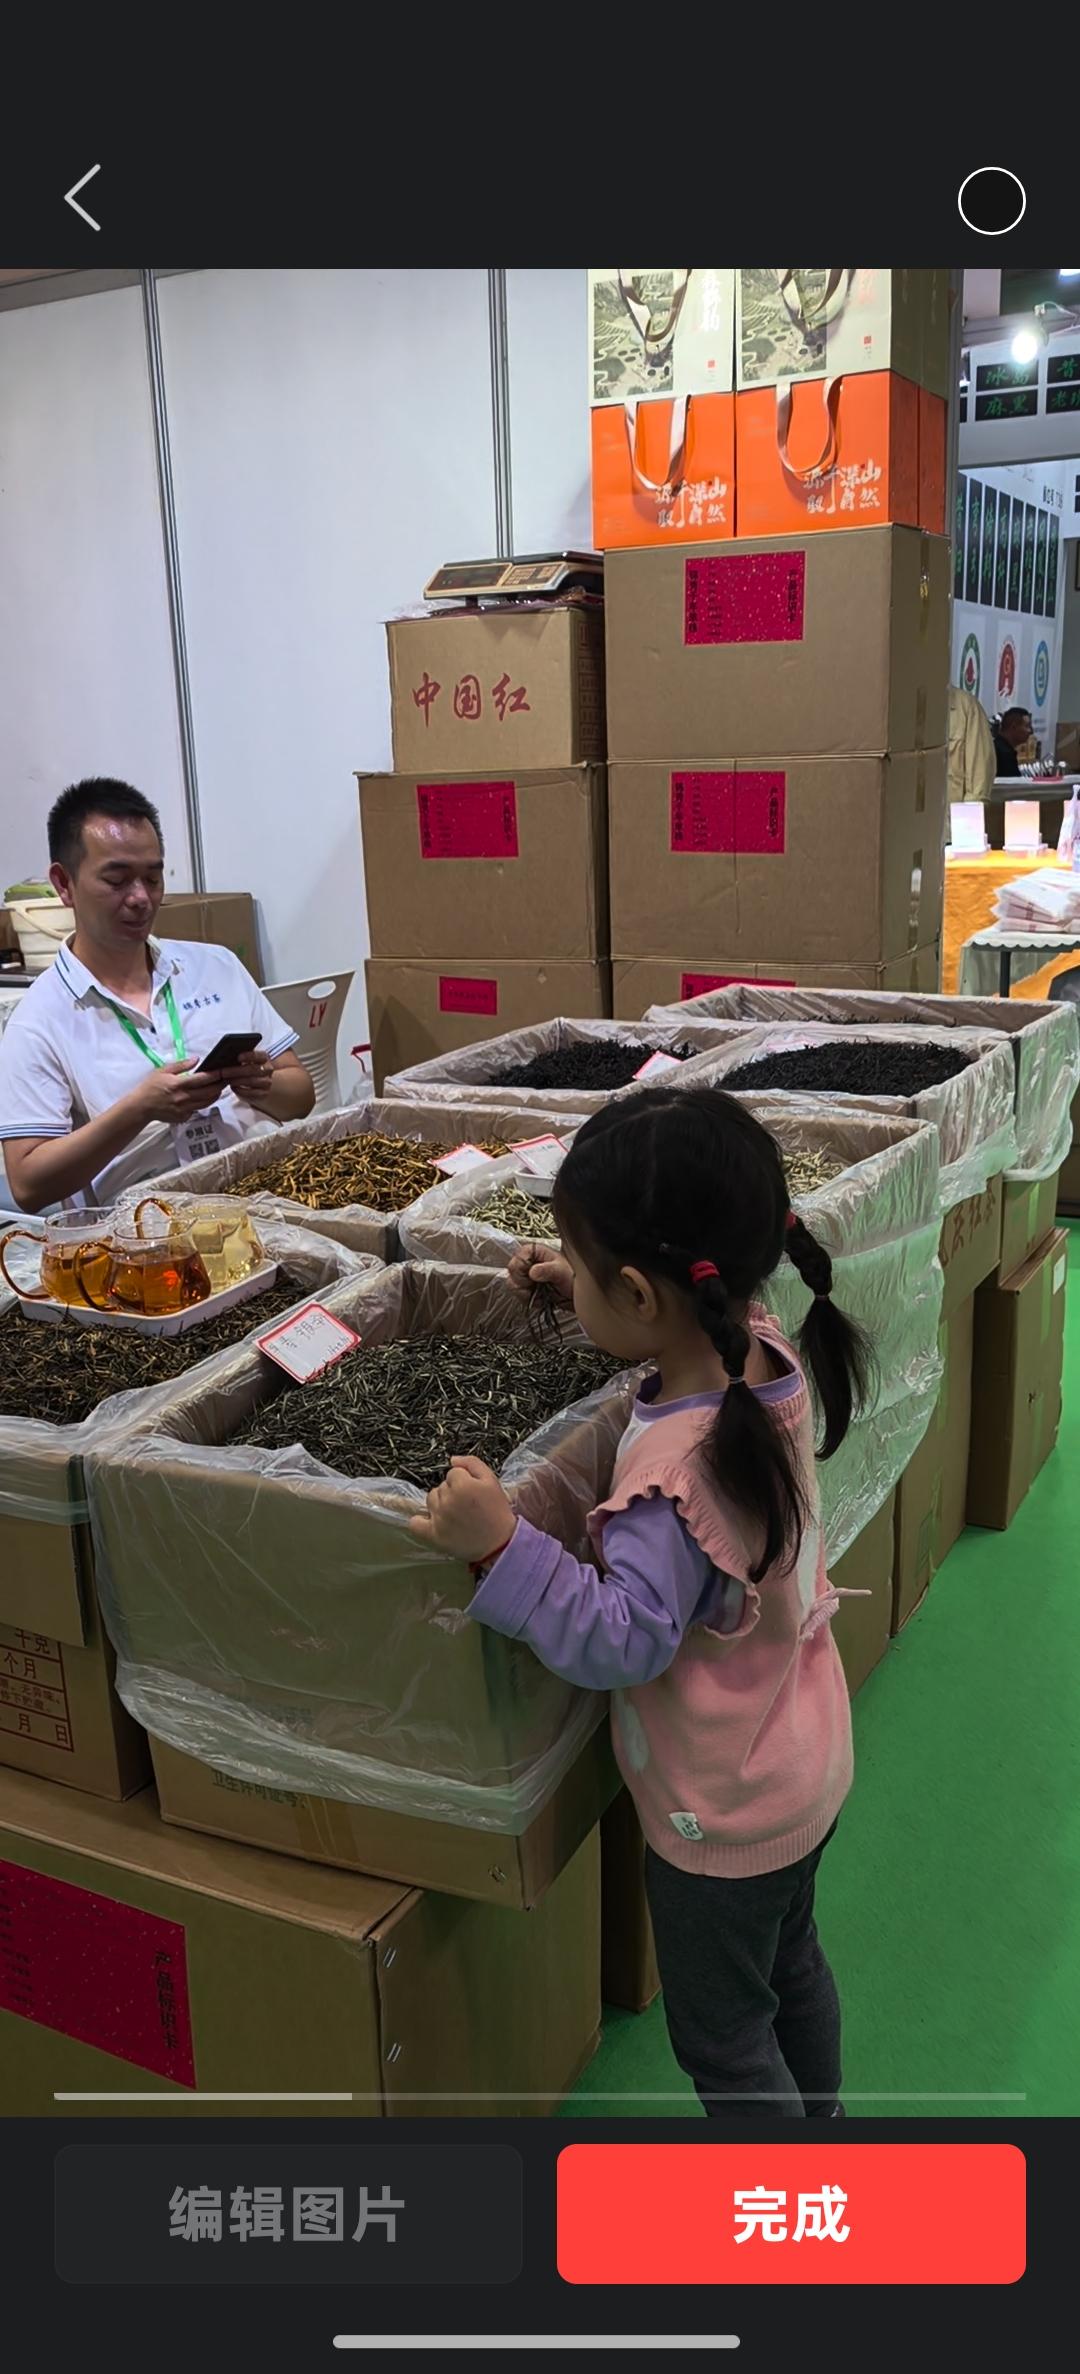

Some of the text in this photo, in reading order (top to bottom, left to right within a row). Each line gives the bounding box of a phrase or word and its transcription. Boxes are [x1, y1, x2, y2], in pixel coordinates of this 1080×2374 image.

[412, 672, 532, 728] 中国红
[309, 1001, 328, 1028] LY
[4, 1652, 36, 1679] 个月
[18, 1713, 69, 1744] 月 日
